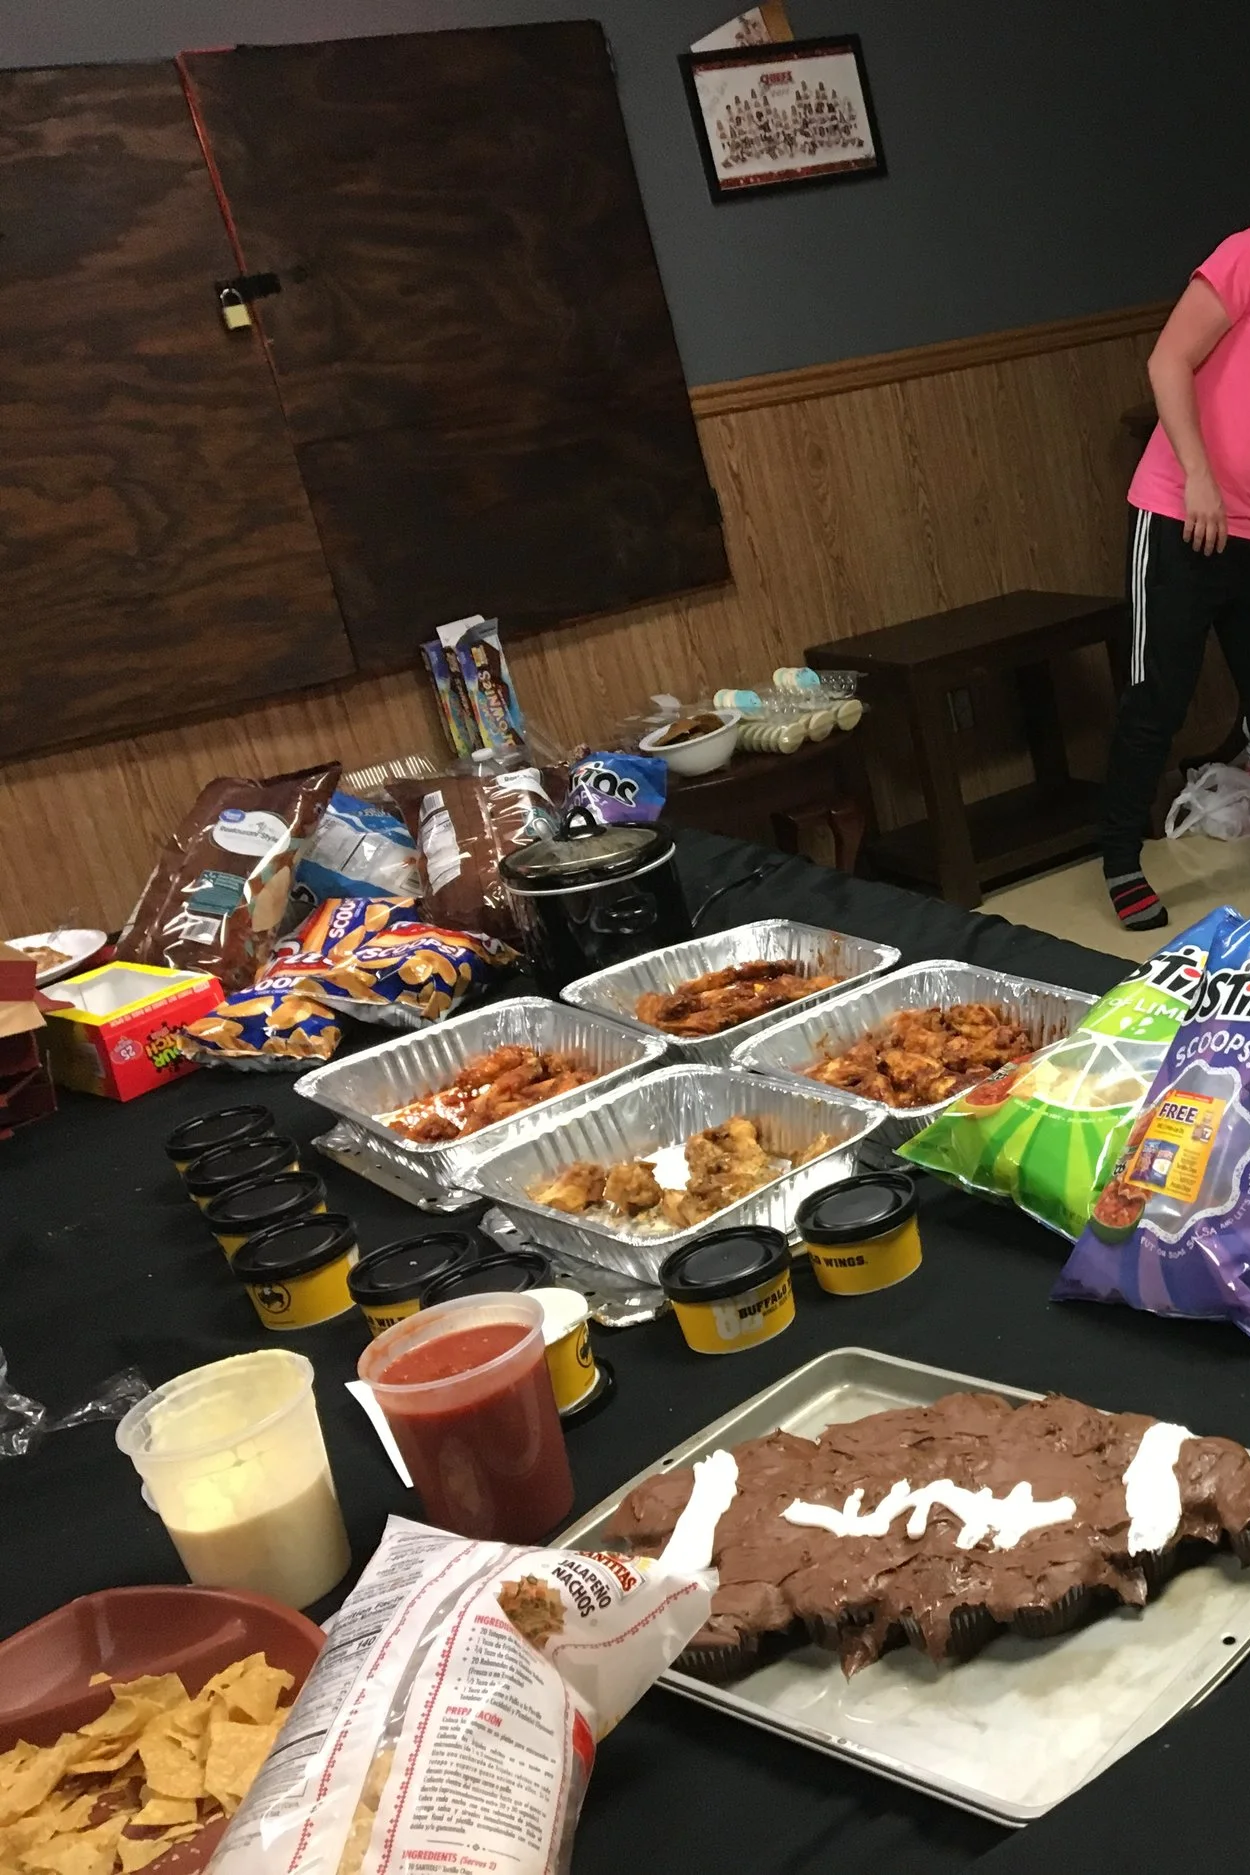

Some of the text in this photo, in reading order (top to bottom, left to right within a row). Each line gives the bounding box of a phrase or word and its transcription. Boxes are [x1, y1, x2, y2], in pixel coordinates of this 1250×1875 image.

[1158, 1102, 1199, 1124] FREE
[737, 1285, 787, 1320] BUFFALO
[551, 1566, 596, 1618] NACHOS
[558, 1559, 612, 1610] JALAPEÑO
[356, 1636, 377, 1650] 140
[401, 1850, 458, 1863] INGREDIENTS
